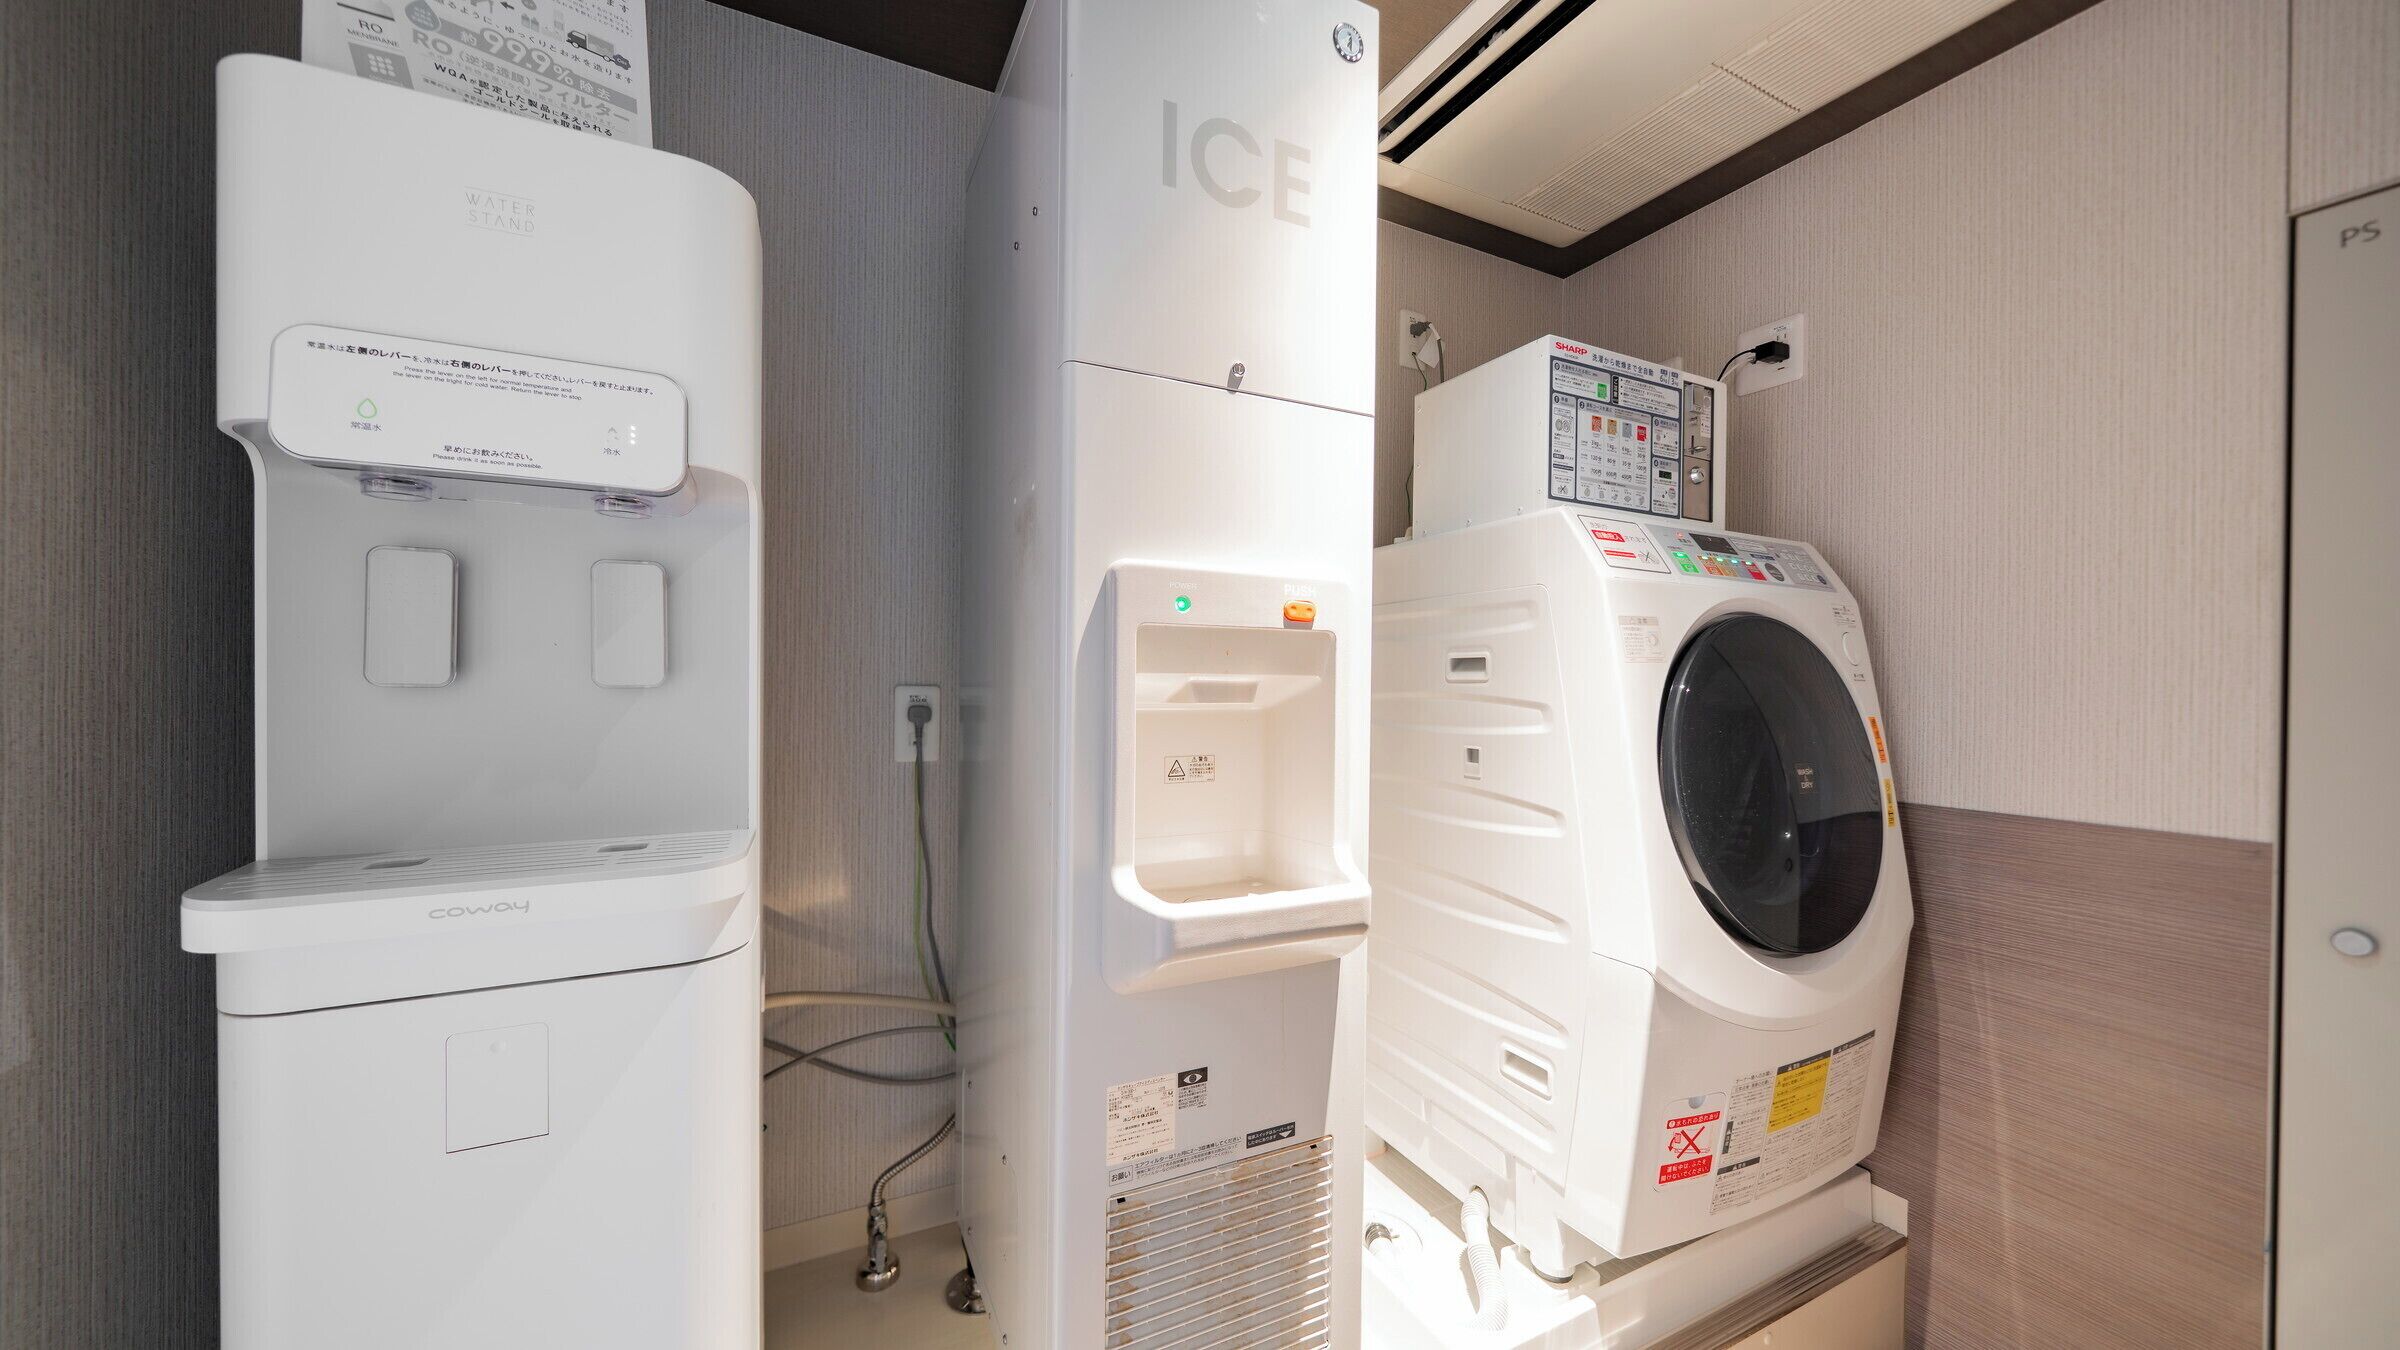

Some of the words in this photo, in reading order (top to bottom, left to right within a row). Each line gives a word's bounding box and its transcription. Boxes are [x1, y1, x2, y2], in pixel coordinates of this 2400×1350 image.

[358, 19, 384, 34] RO
[1163, 99, 1311, 229] ICE
[464, 192, 535, 217] WATER
[468, 209, 535, 233] STAND
[2341, 220, 2381, 248] PS
[1555, 342, 1588, 356] SHARP
[1592, 354, 1654, 377] 洗濯から乾燥まで全自動
[404, 366, 424, 374] Press
[437, 370, 454, 378] lever
[523, 382, 559, 392] temperature
[475, 381, 488, 389] cold
[511, 386, 532, 394] Return
[351, 421, 382, 432] 常温水
[444, 445, 534, 461] 早めにお飲みください。
[603, 447, 621, 456] 冷水
[433, 453, 455, 461] Please
[516, 462, 544, 470] possible.
[1797, 768, 1813, 776] WASH
[428, 900, 530, 919] coway
[1112, 1171, 1131, 1182] お願い
